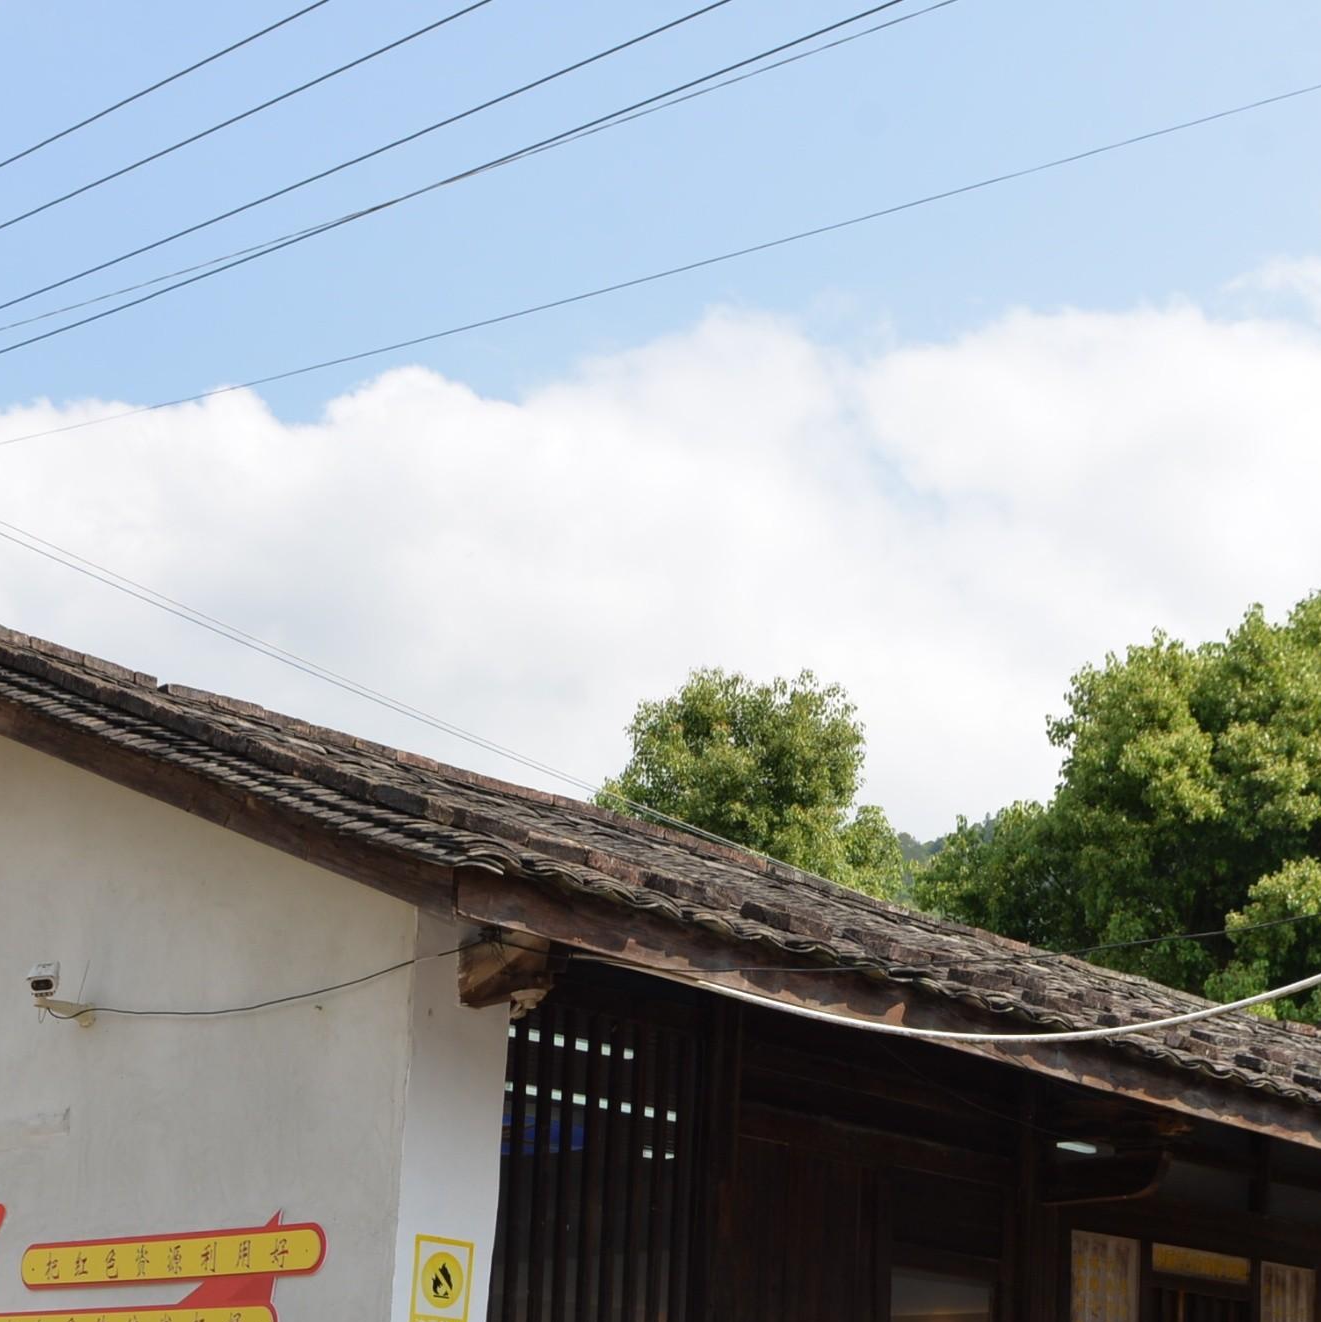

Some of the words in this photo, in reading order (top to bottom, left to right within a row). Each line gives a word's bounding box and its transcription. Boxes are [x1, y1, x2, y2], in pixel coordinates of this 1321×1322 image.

[44, 1237, 290, 1281] 把红色资源利用好
